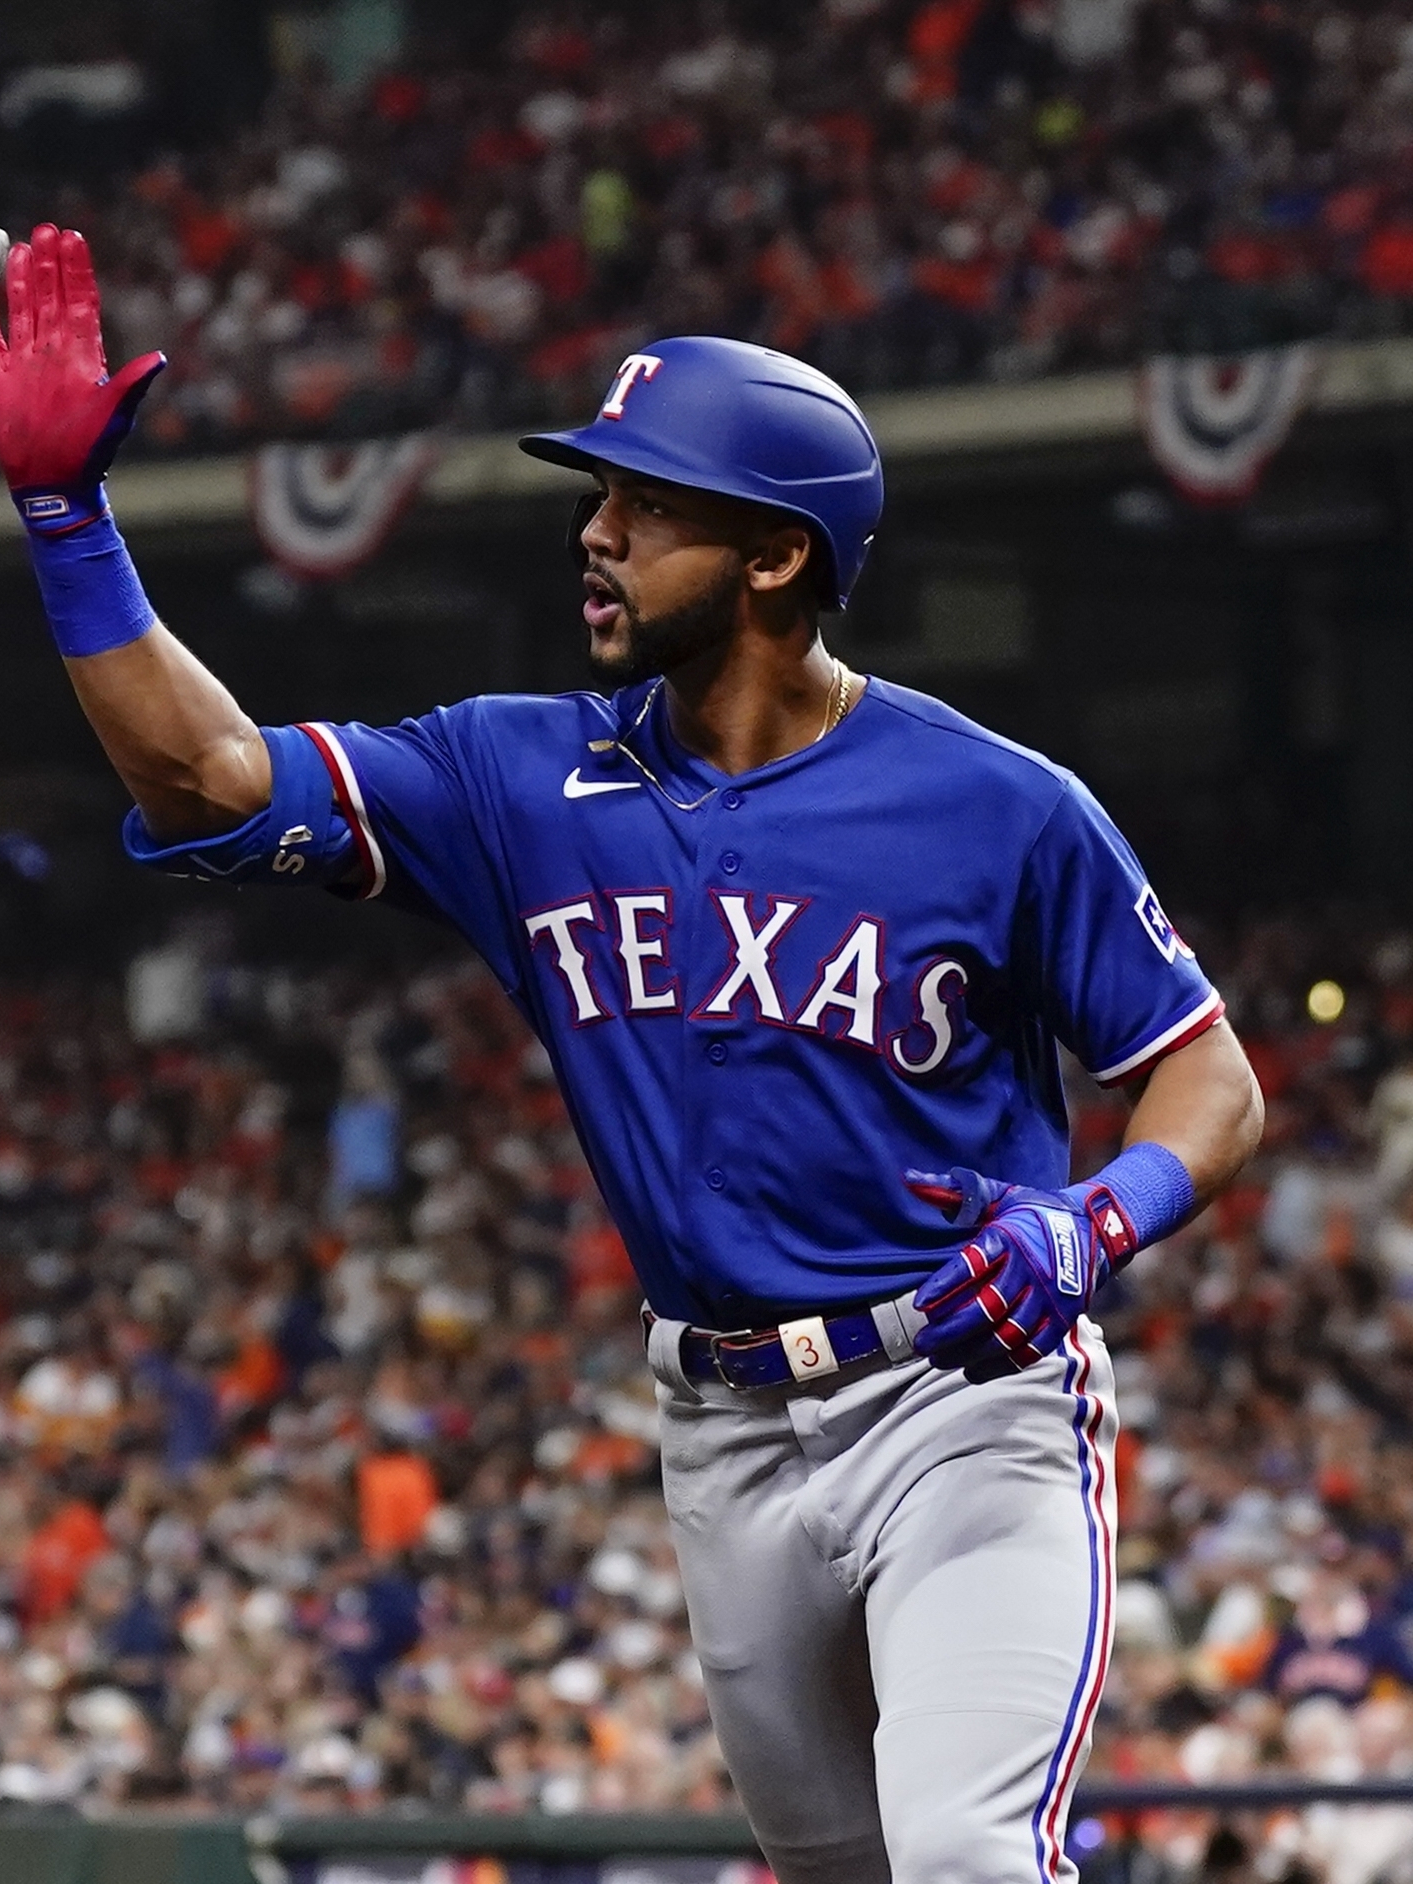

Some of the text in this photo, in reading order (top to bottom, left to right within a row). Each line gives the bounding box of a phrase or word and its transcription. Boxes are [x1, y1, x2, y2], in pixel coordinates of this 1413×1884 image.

[601, 353, 664, 421] T
[520, 888, 969, 1079] TEXAS
[795, 1335, 820, 1368] 3
